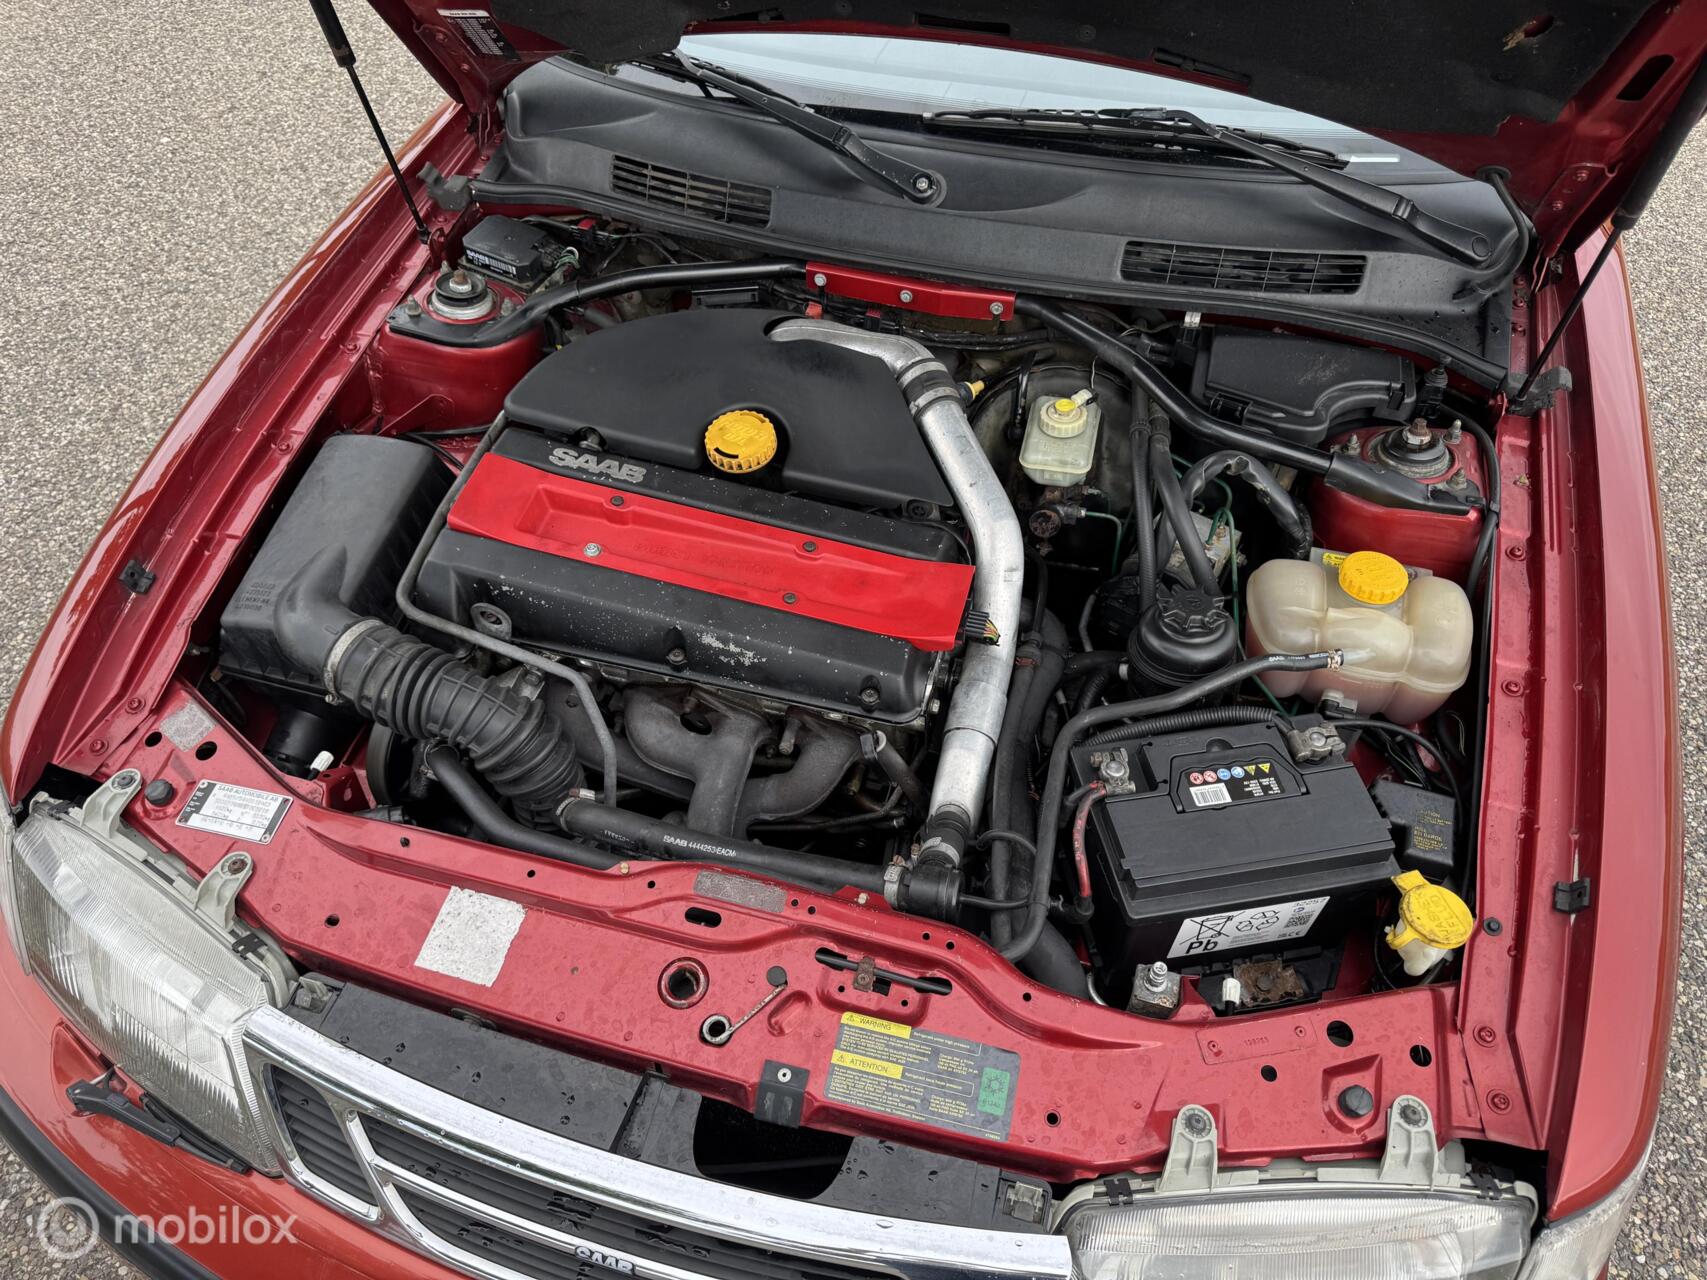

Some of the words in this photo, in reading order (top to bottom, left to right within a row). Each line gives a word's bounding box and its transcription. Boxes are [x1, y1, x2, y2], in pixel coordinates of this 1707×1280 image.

[548, 447, 647, 483] SAAB
[663, 834, 688, 847] SAAB
[1185, 938, 1219, 955] Pb
[860, 1017, 892, 1031] WARNING
[849, 1056, 889, 1074] ATTENTION
[575, 1245, 636, 1276] SAAB
